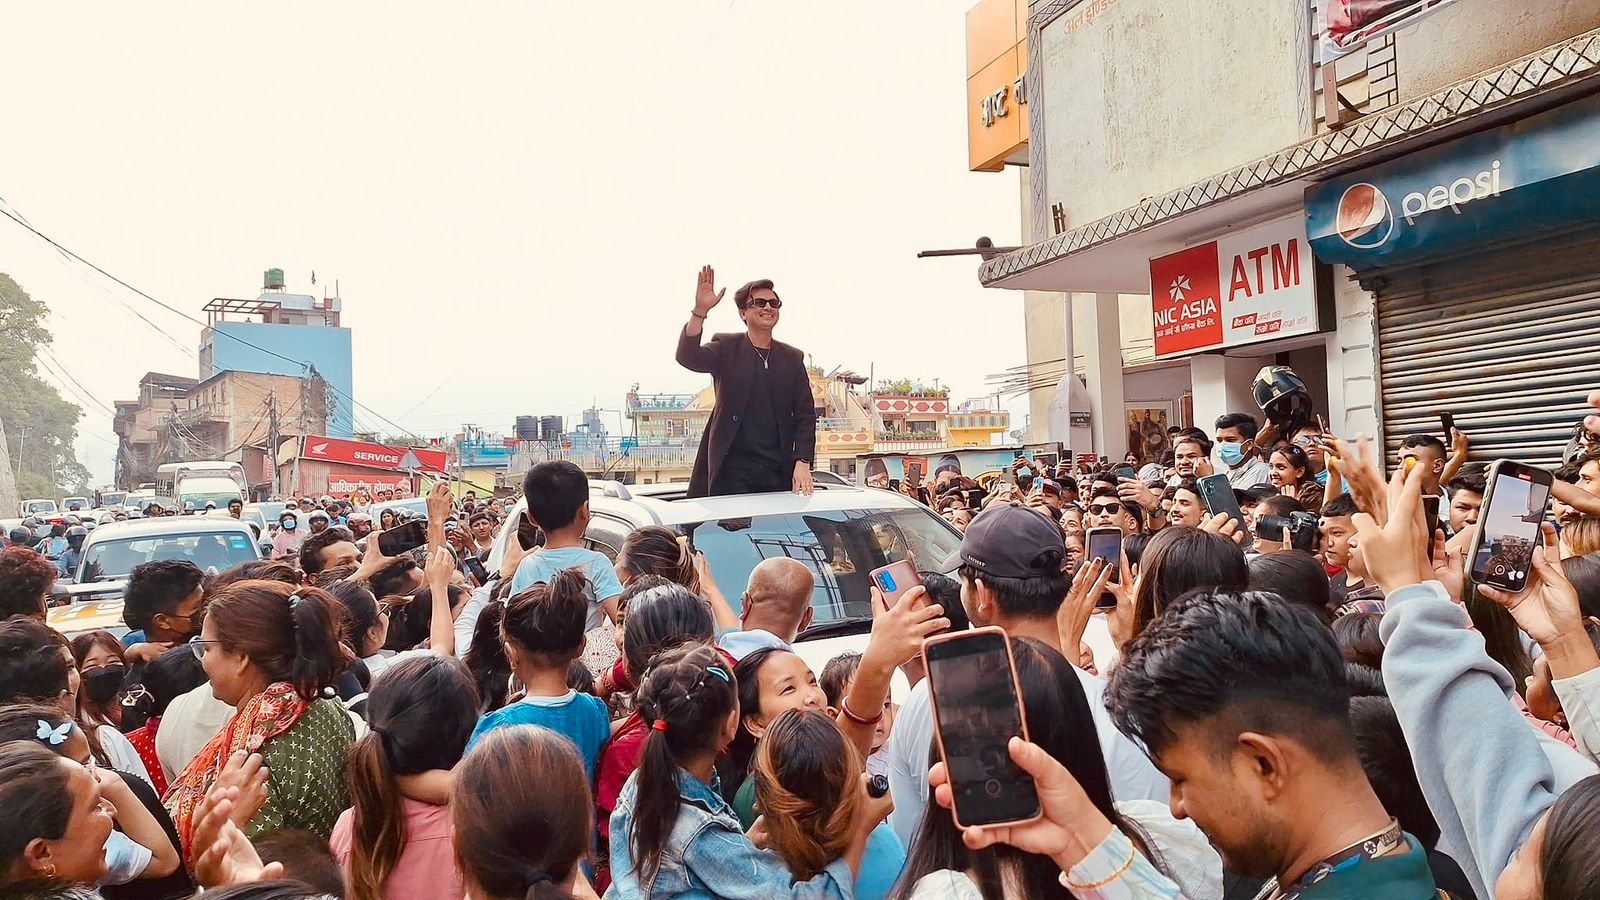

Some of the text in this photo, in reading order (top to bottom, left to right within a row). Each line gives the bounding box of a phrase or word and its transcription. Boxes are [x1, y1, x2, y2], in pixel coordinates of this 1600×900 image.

[1401, 159, 1501, 226] pepsi
[1228, 238, 1300, 302] ATM
[1153, 297, 1217, 328] NIC ASIA
[353, 451, 399, 464] SERVICE
